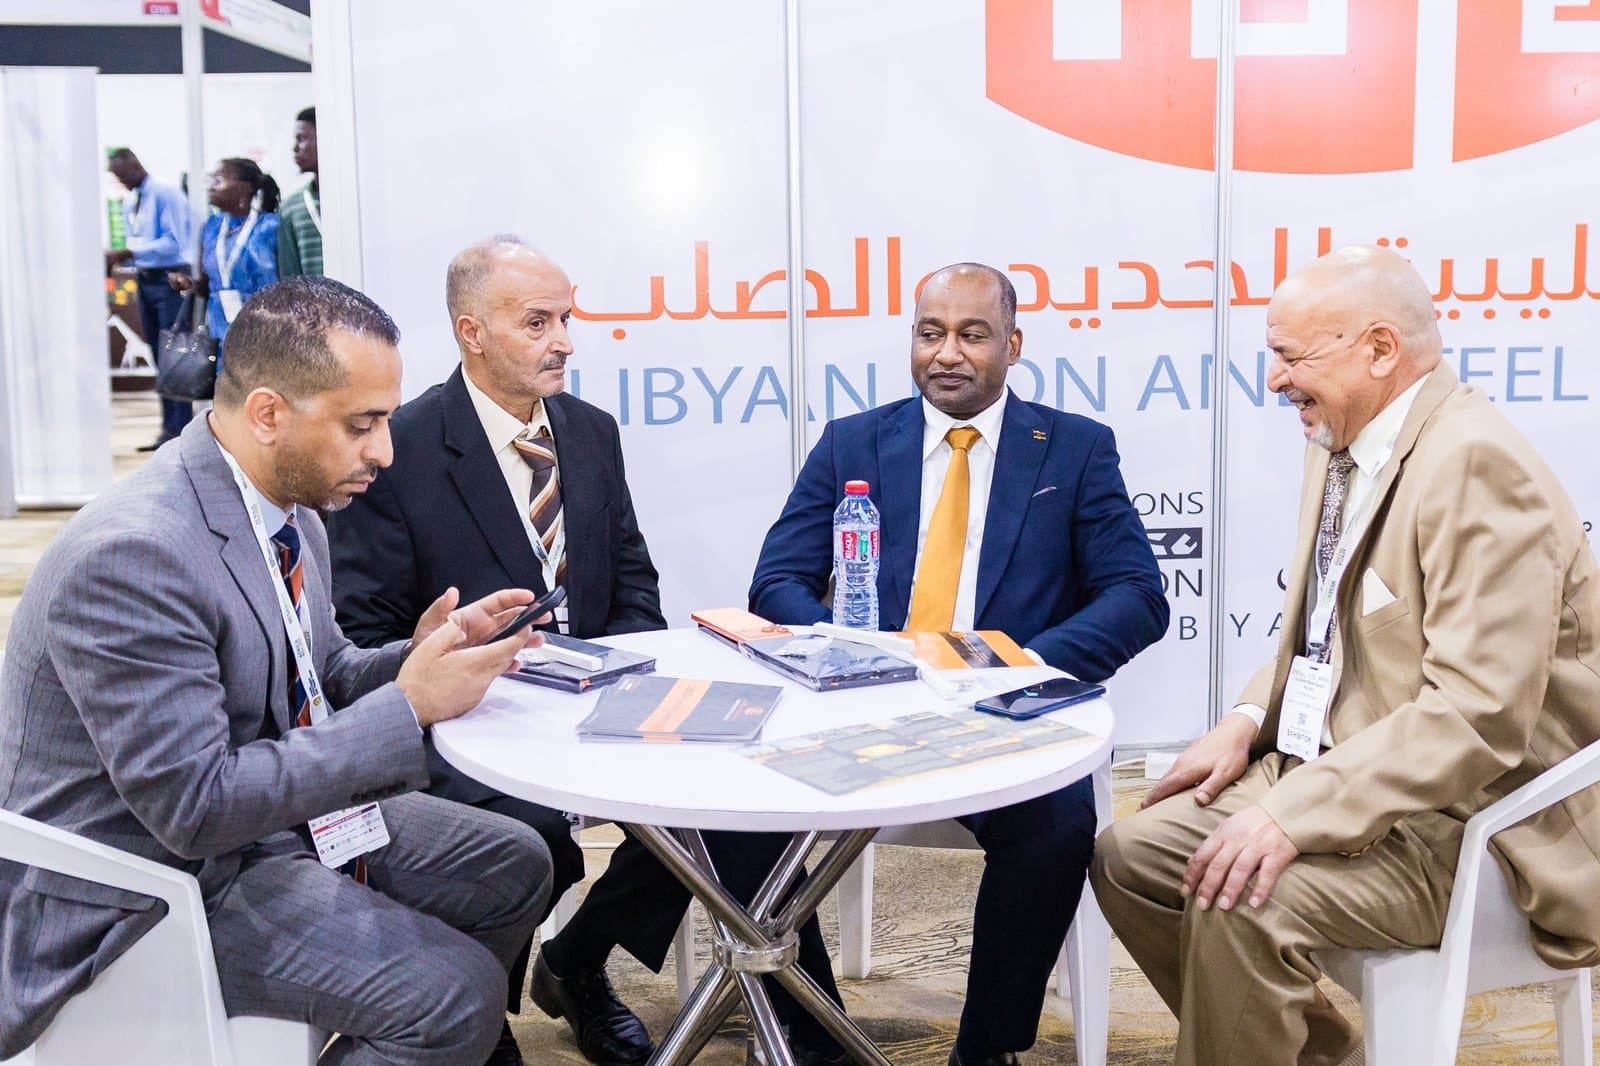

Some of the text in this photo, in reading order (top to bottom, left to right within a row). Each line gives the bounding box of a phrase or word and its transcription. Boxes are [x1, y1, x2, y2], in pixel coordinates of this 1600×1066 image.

[571, 236, 934, 340] الصلب
[1136, 351, 1297, 411] AN
[1442, 346, 1589, 402] EEL
[1131, 491, 1204, 515] ONS
